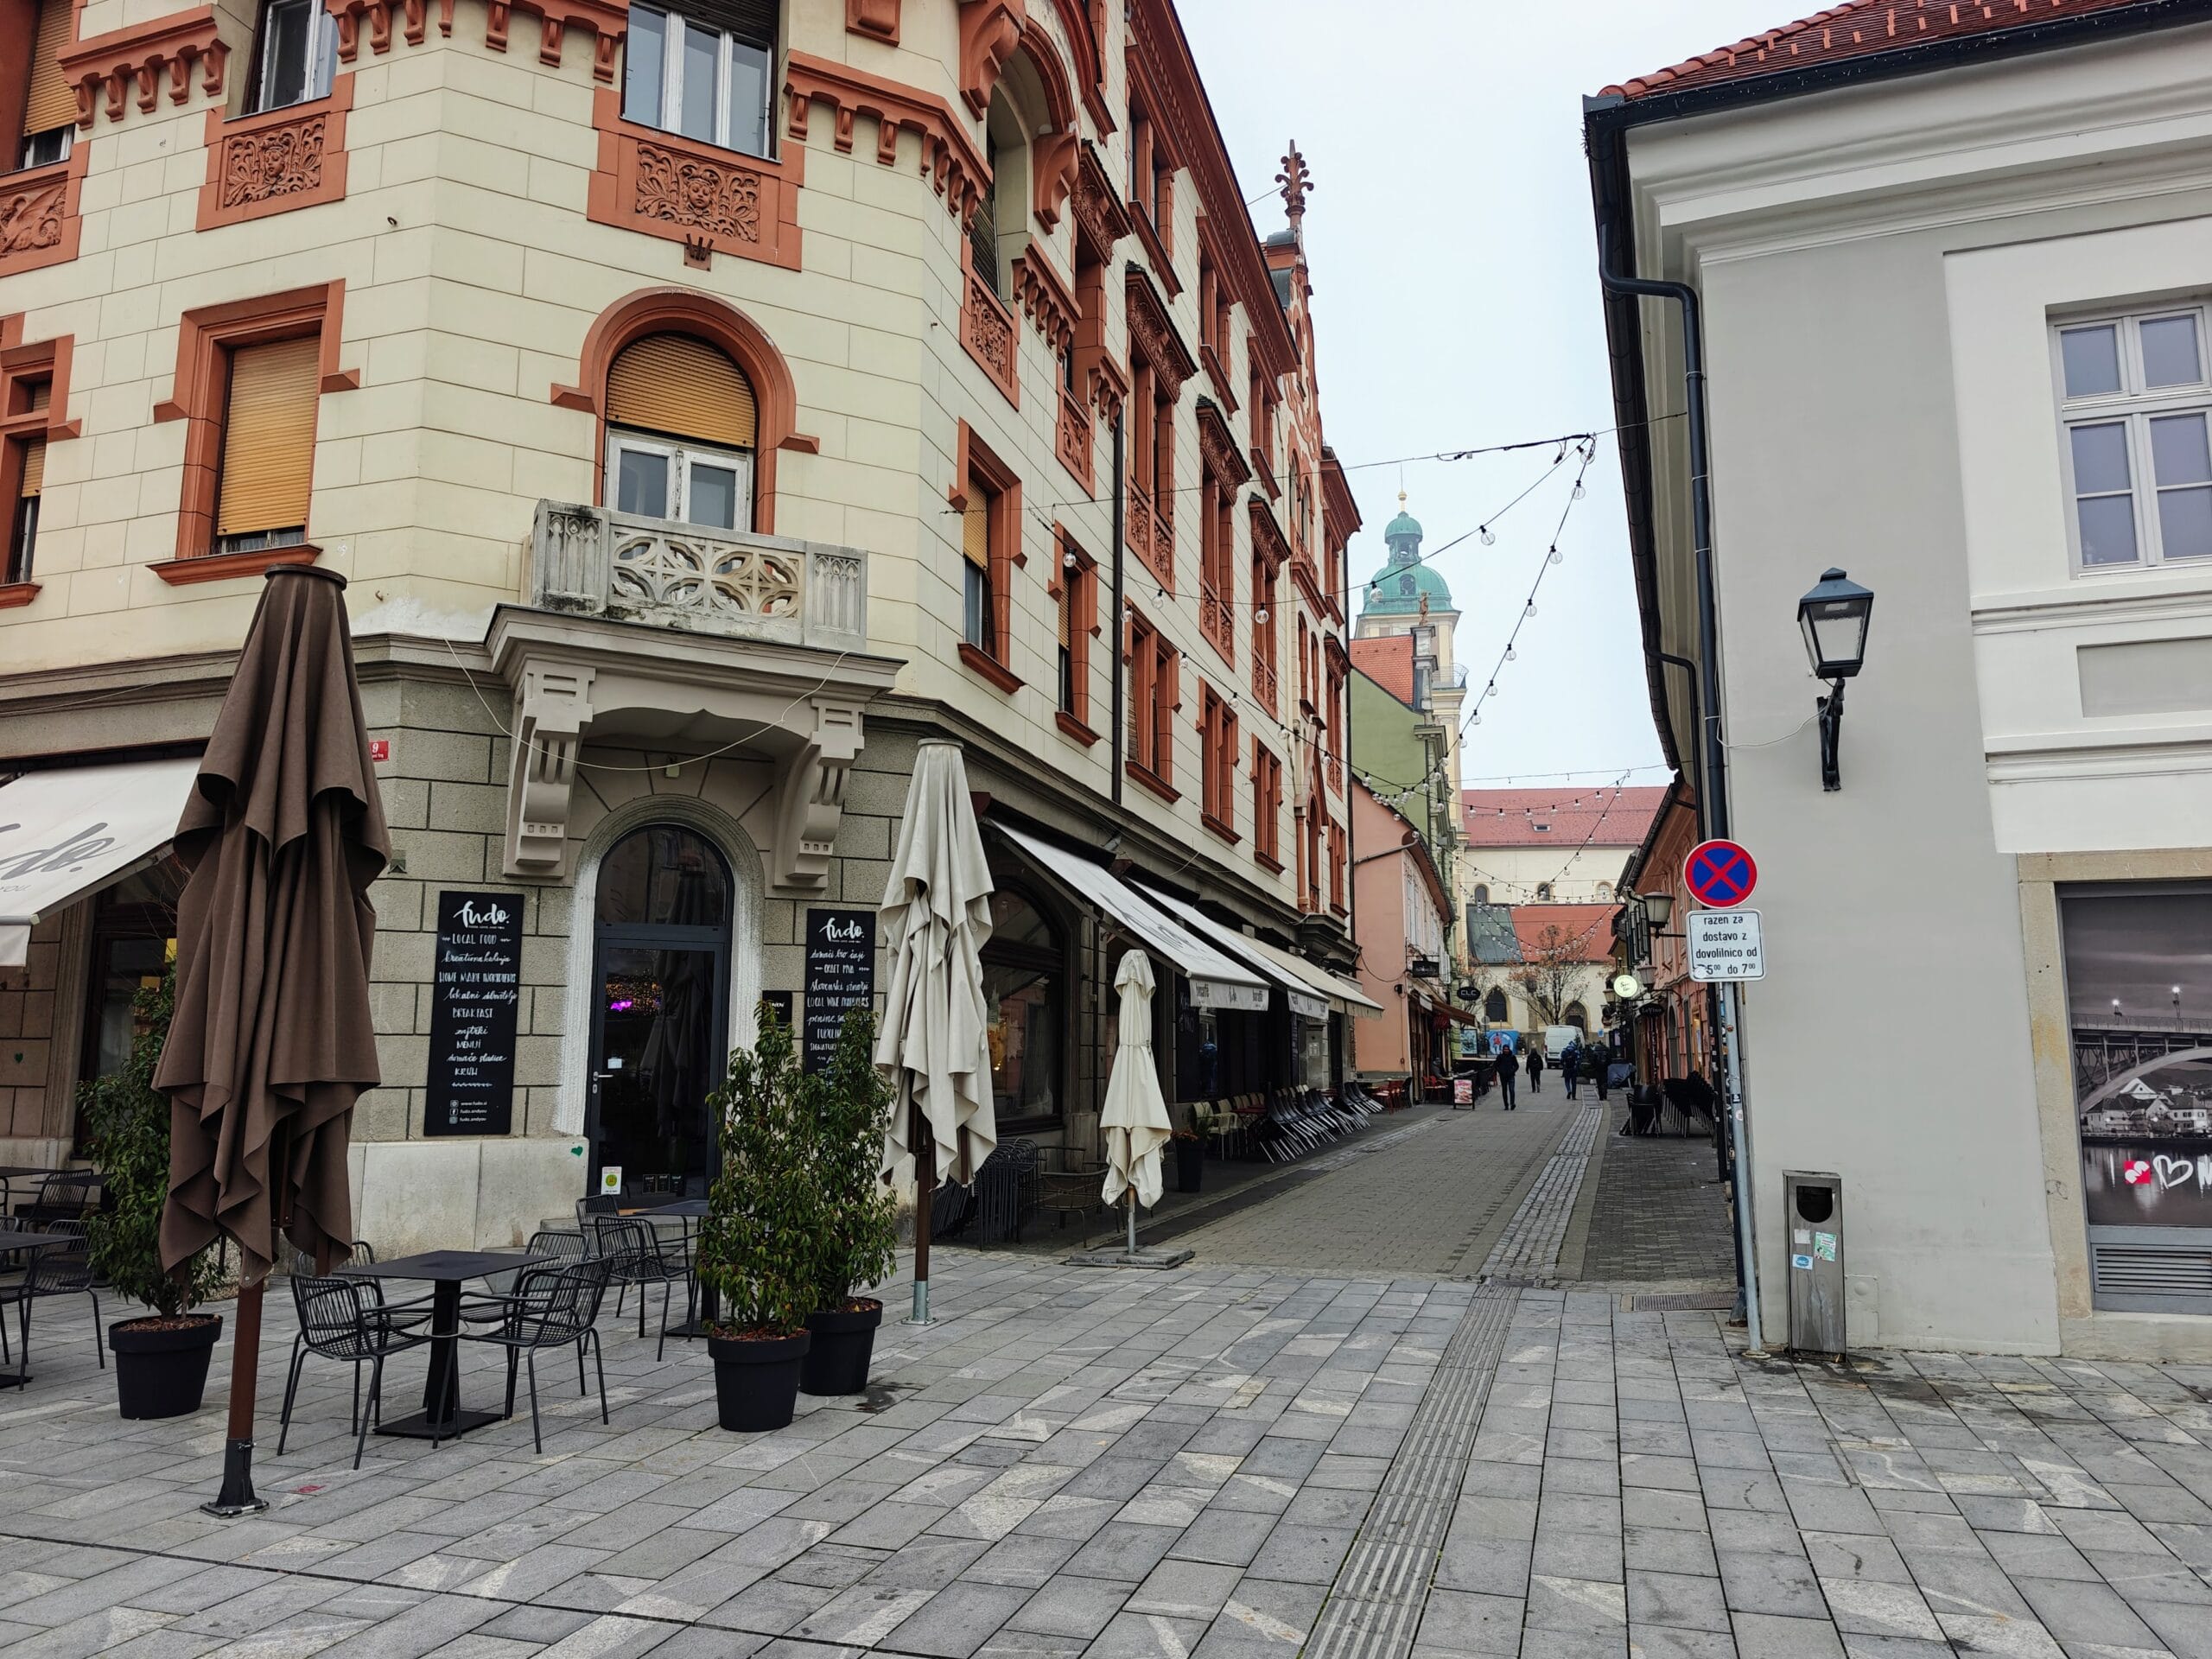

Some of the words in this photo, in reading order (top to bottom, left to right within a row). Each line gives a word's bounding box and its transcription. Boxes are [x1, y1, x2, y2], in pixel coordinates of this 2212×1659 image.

[1703, 916, 1728, 925] razen
[452, 933, 476, 944] LOCAL
[480, 934, 498, 944] FOOD
[1702, 931, 1738, 942] dostavo
[1695, 948, 1743, 959] dovolilnico
[1746, 946, 1758, 957] od
[1727, 964, 1738, 974] do
[439, 971, 457, 982] HOME
[807, 996, 824, 1007] LOCAL
[452, 1007, 493, 1018] BREAKFAST
[454, 1067, 478, 1076] KRUH
